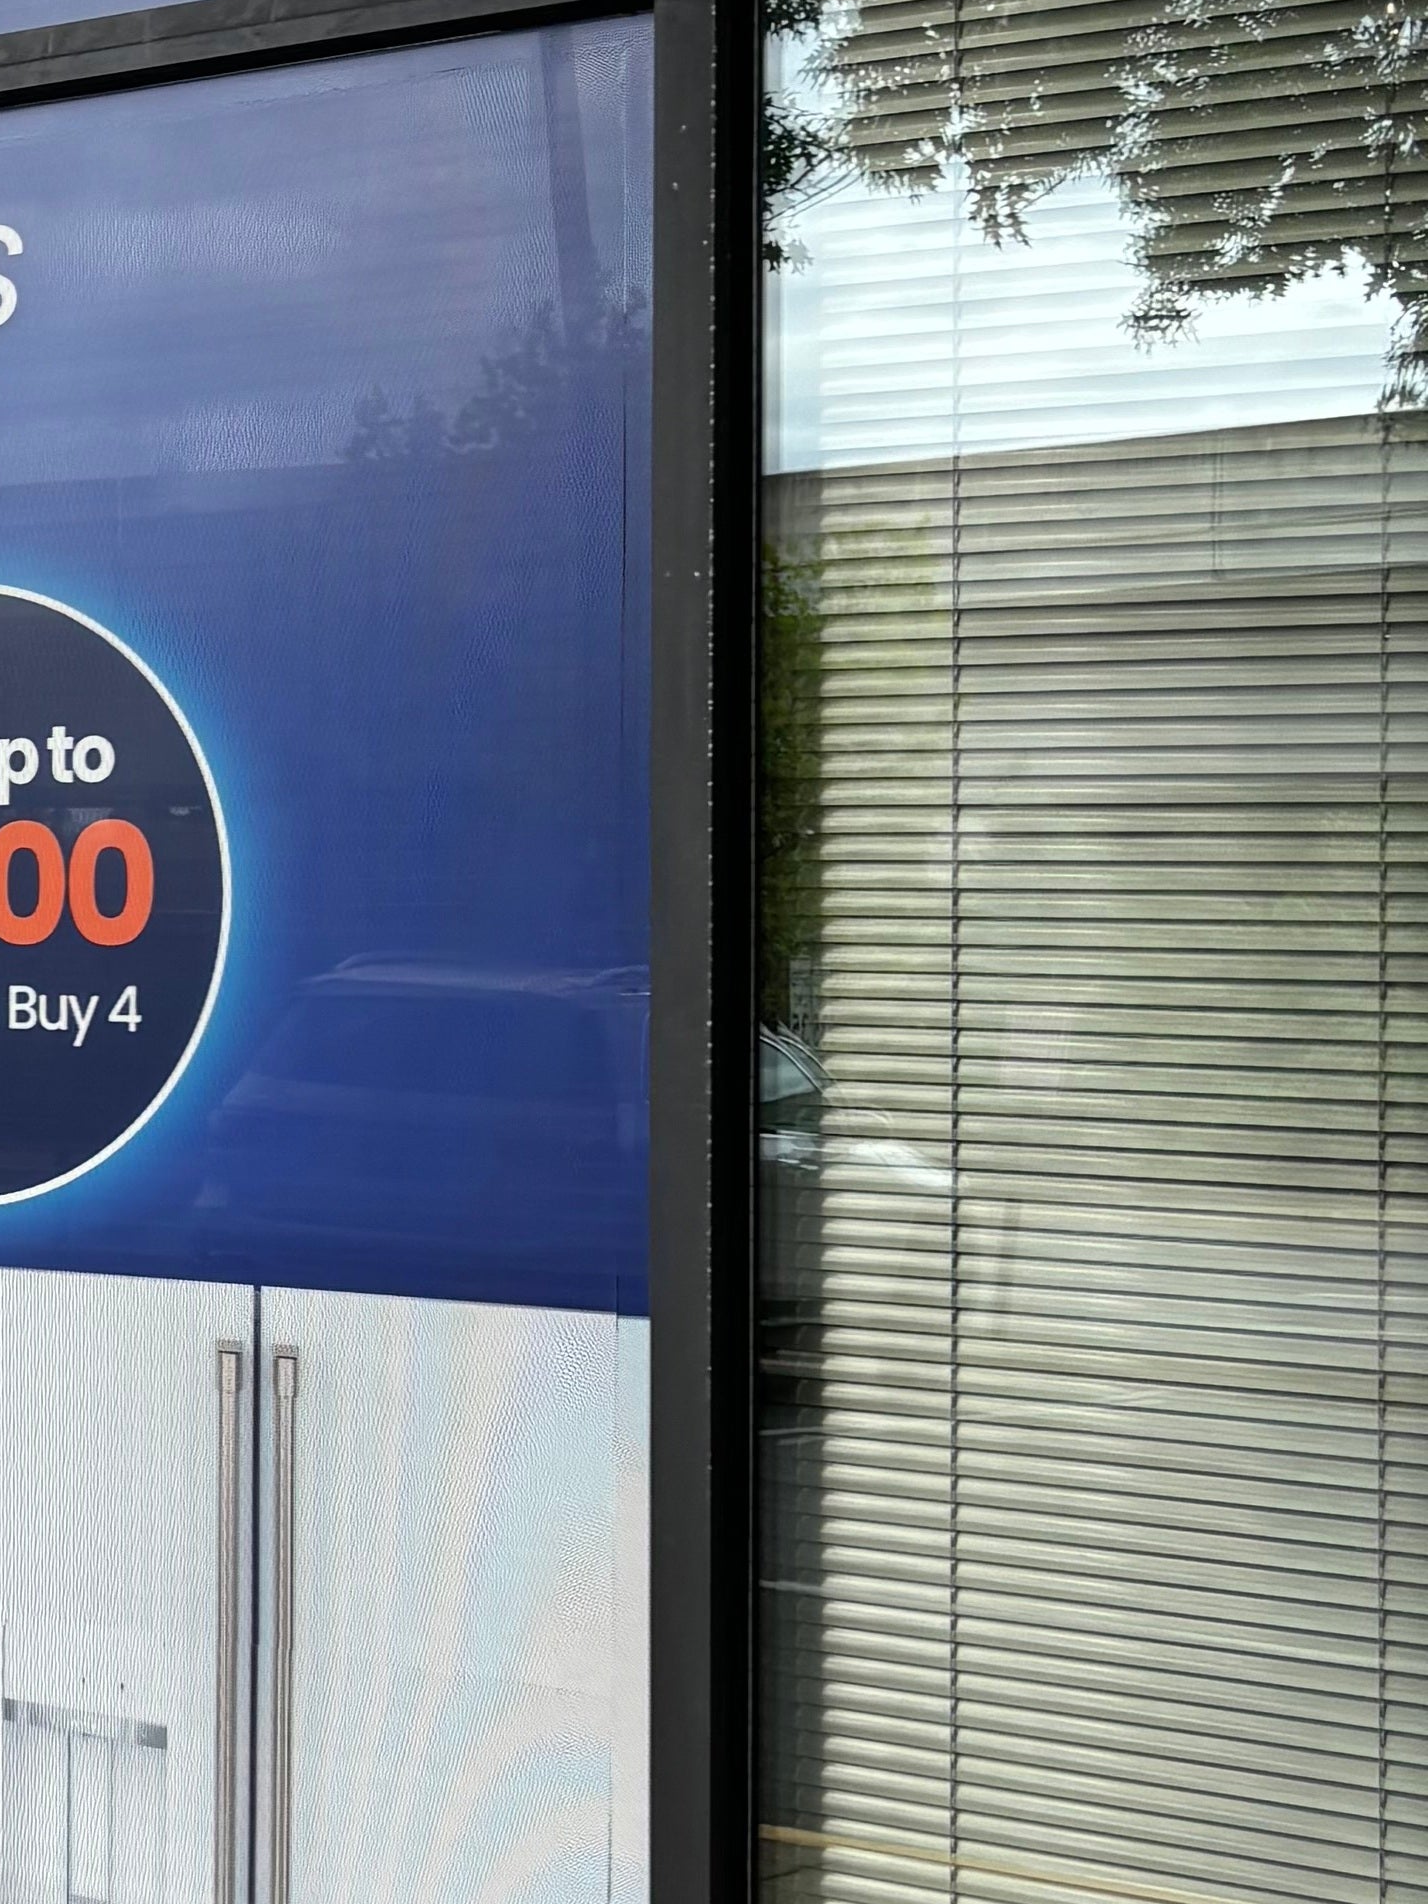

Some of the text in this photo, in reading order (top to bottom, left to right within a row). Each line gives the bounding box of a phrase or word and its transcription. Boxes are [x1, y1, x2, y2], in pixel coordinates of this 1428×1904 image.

[46, 725, 116, 785] to
[8, 984, 100, 1048] Buy
[108, 985, 143, 1033] 4
